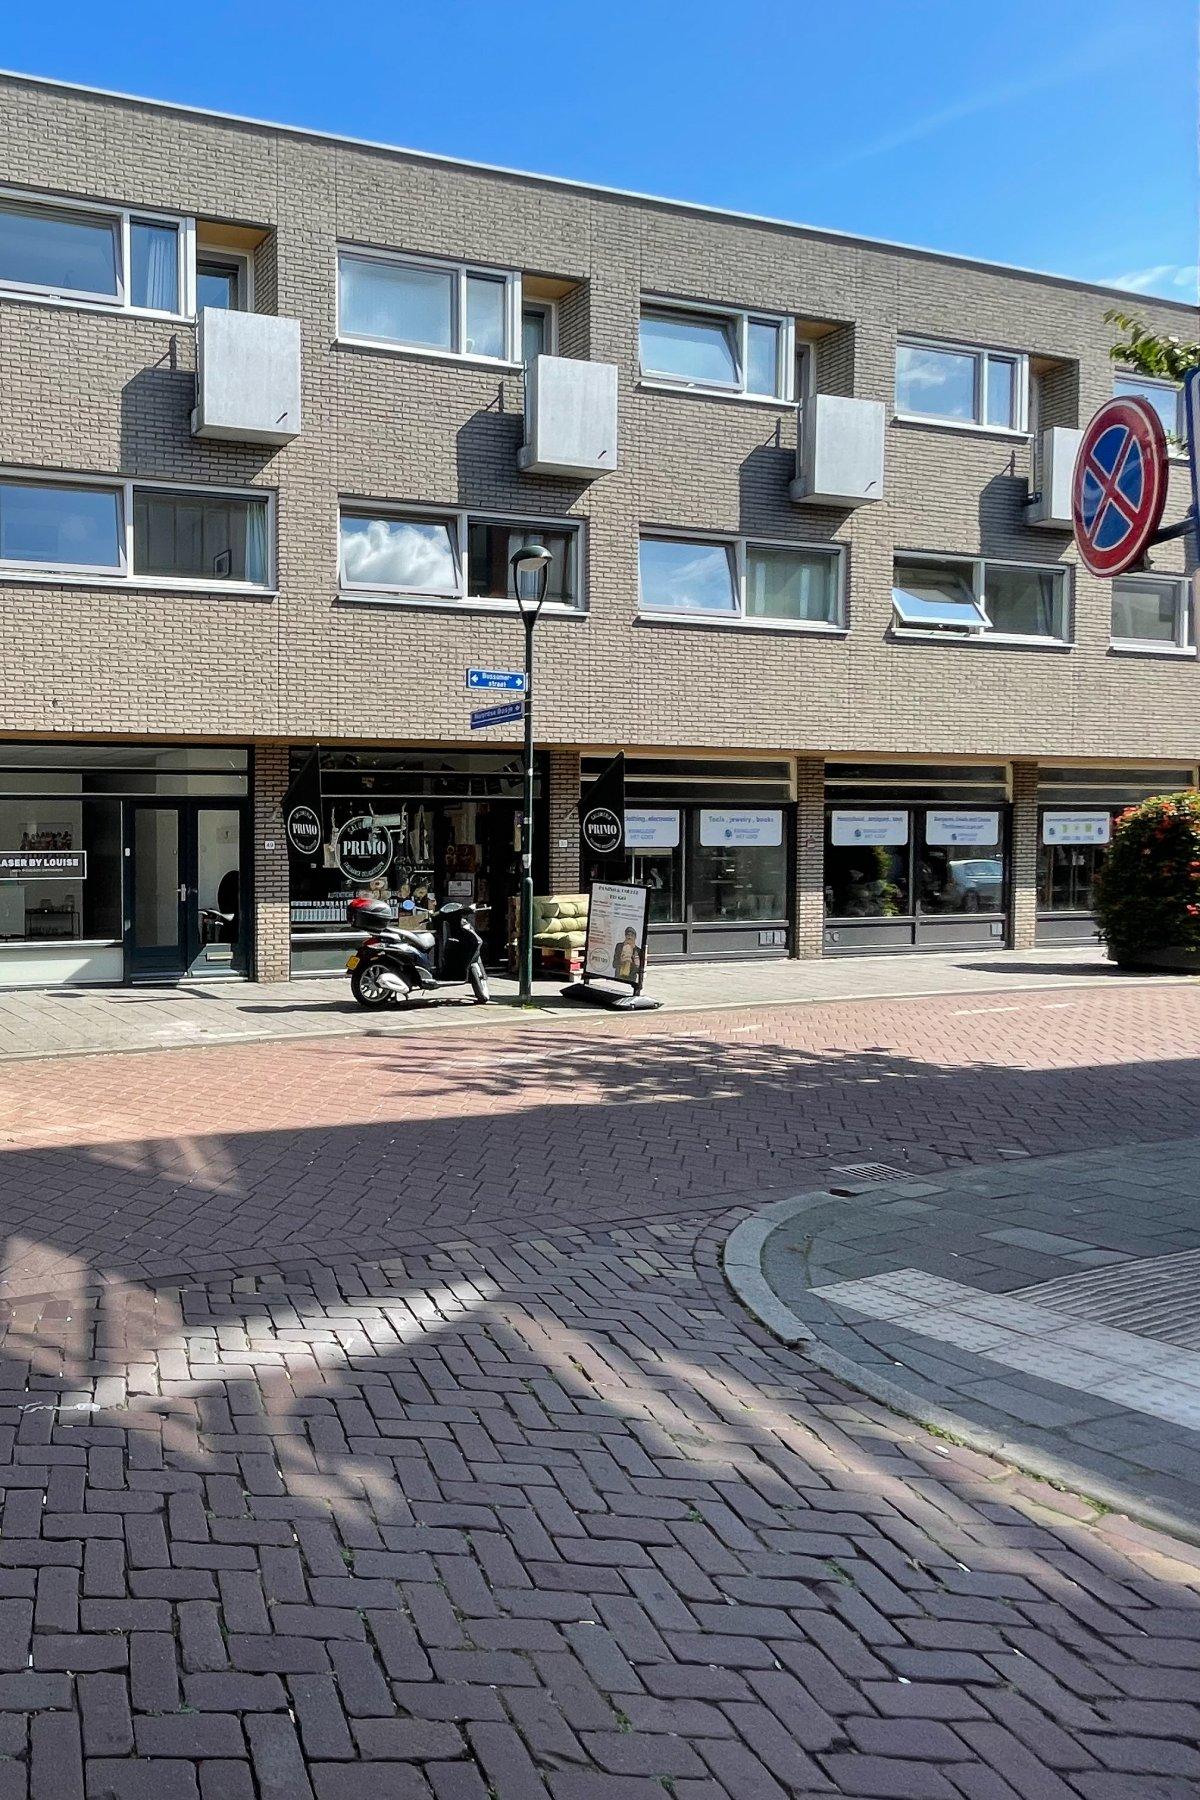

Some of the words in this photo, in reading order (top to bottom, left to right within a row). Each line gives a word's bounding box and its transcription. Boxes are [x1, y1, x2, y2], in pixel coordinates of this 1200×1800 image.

[488, 680, 507, 688] straat
[292, 823, 318, 836] PRIMO
[587, 823, 618, 835] PRIMO
[342, 840, 387, 856] PRIMO
[28, 858, 43, 867] BY
[43, 858, 79, 867] LOUISE
